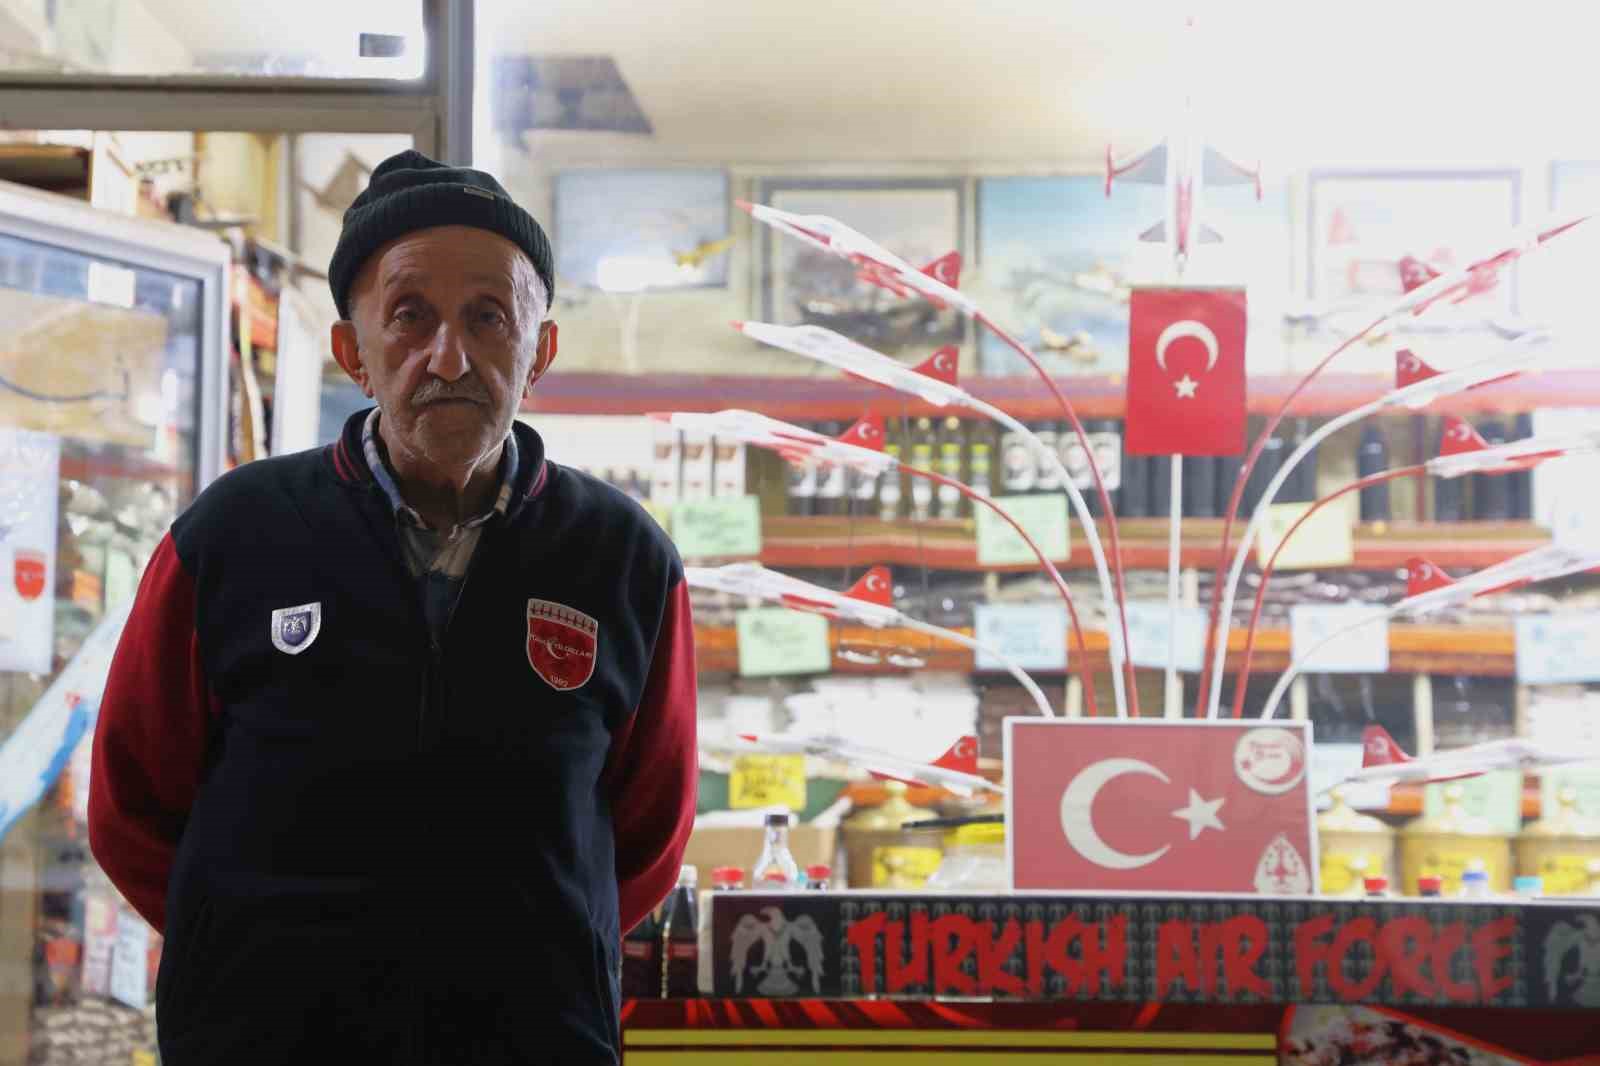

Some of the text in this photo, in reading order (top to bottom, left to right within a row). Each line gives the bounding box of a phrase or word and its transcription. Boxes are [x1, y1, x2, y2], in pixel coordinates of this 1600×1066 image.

[847, 908, 1519, 1001] TURKISH AIR FORCE
